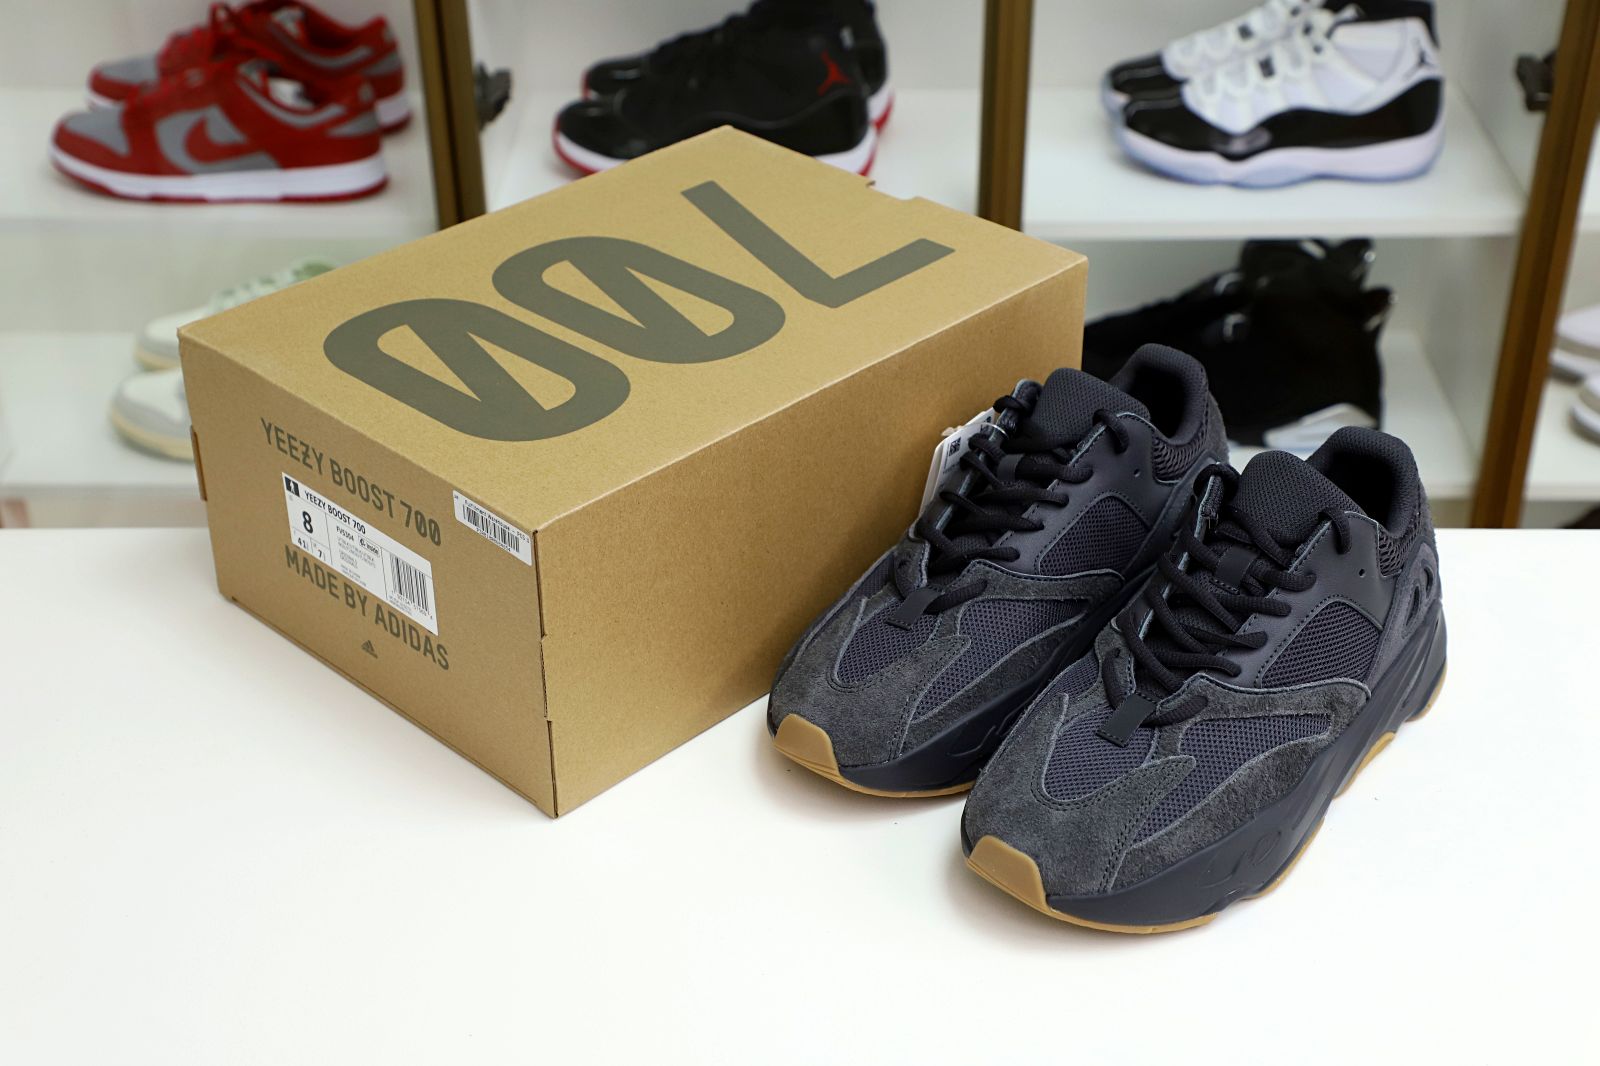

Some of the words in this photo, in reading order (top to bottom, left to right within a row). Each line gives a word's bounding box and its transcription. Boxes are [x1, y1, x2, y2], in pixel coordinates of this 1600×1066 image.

[323, 180, 956, 442] 700
[261, 417, 323, 475] YEEZY
[330, 458, 394, 518] BOOST
[400, 500, 441, 546] 700
[302, 510, 314, 534] 8
[304, 490, 326, 510] YEEZY
[327, 504, 351, 526] BOOST
[352, 519, 366, 535] 700
[285, 544, 340, 599] MADE
[343, 582, 368, 616] BY
[374, 603, 449, 670] ADIDAS
